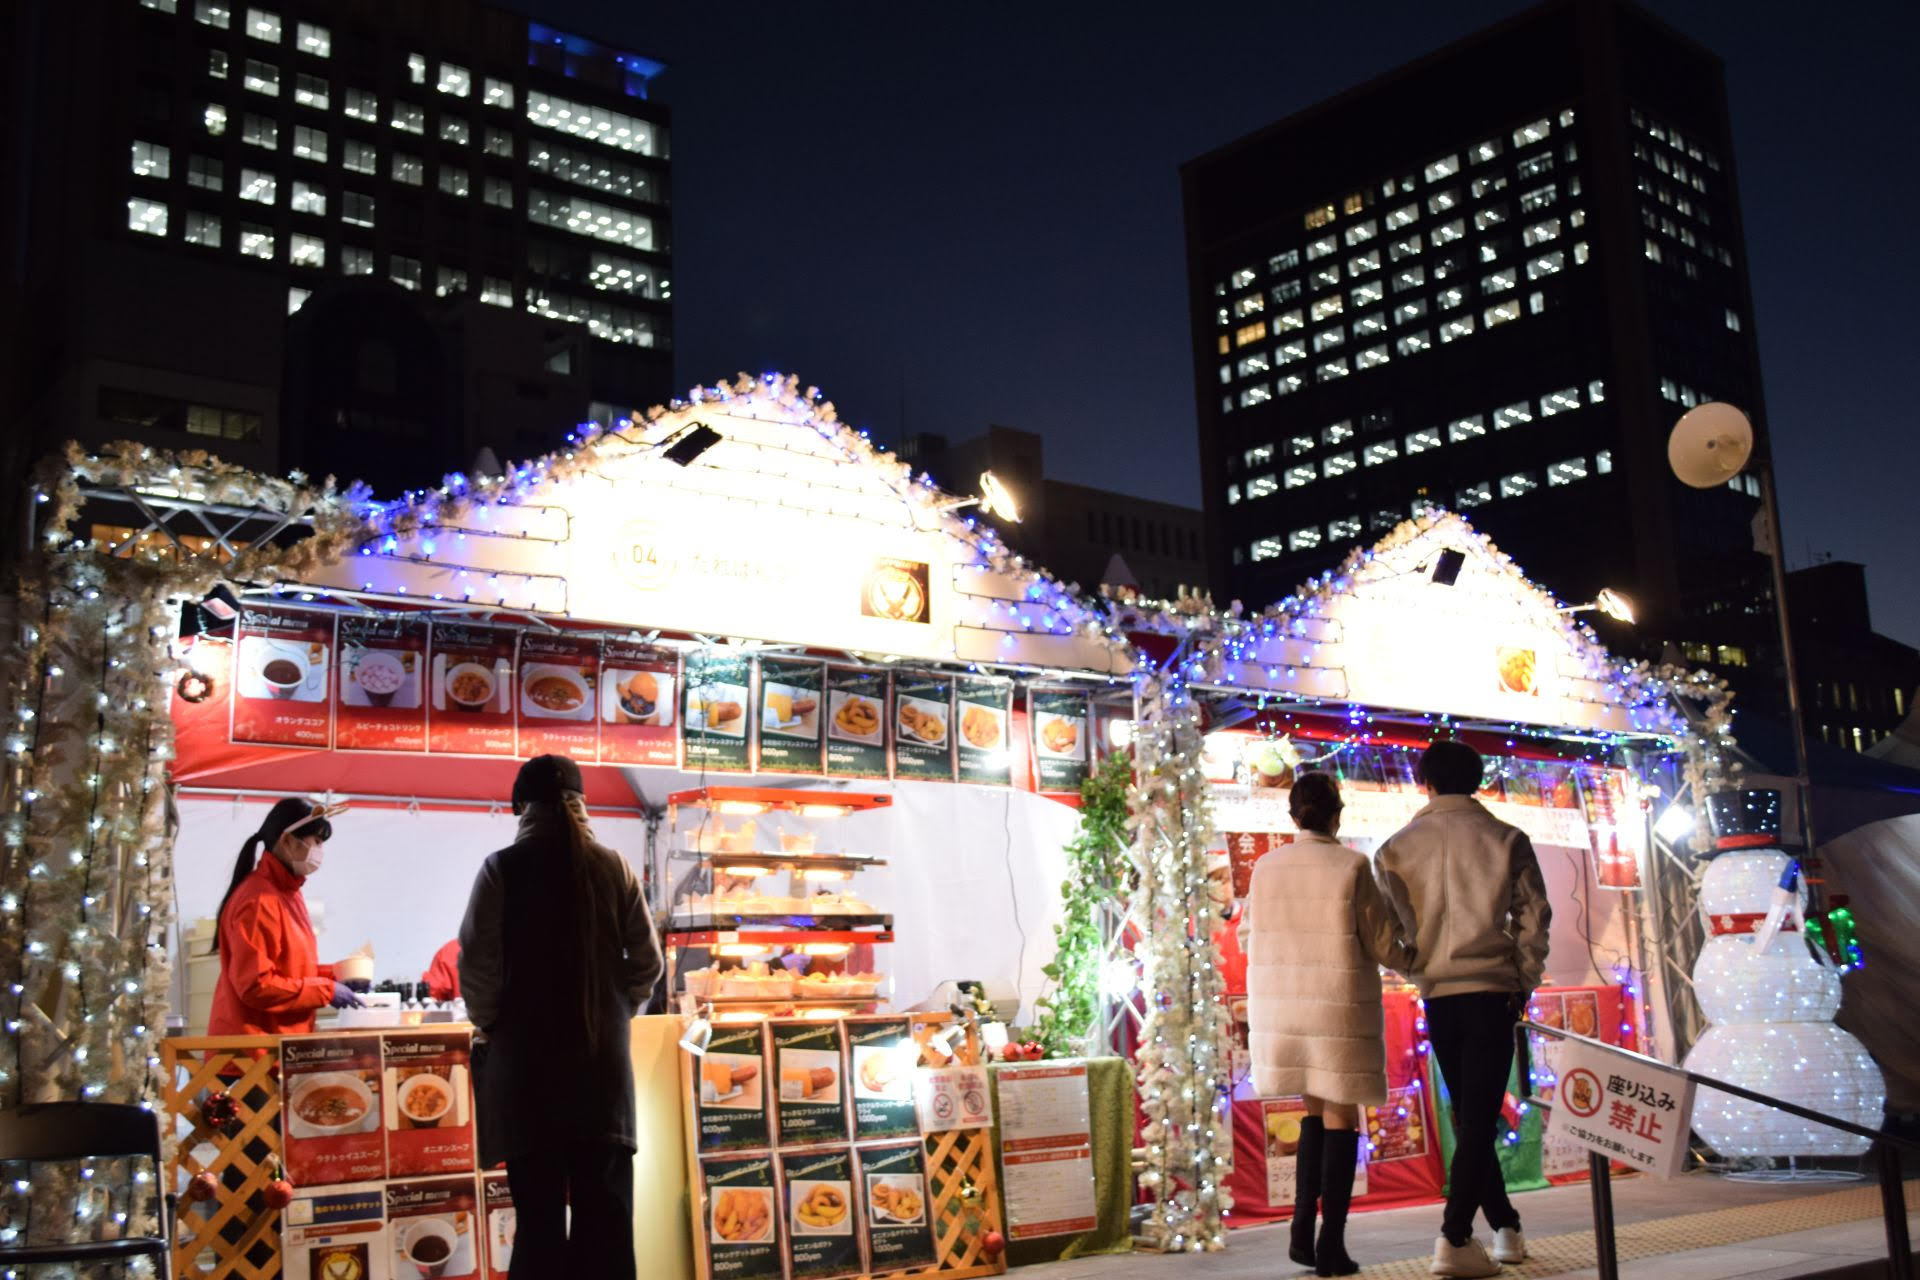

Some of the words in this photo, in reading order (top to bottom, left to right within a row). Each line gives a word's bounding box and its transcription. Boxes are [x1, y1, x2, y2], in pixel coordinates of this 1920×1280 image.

[633, 544, 657, 565] 04
[286, 1046, 325, 1062] Special
[327, 1048, 354, 1057] menu
[383, 1041, 419, 1056] Special
[420, 1044, 446, 1053] menu
[1606, 1074, 1676, 1112] 座り込み
[1608, 1099, 1662, 1144] 禁止
[386, 1190, 423, 1206] Special
[425, 1191, 450, 1200] menu
